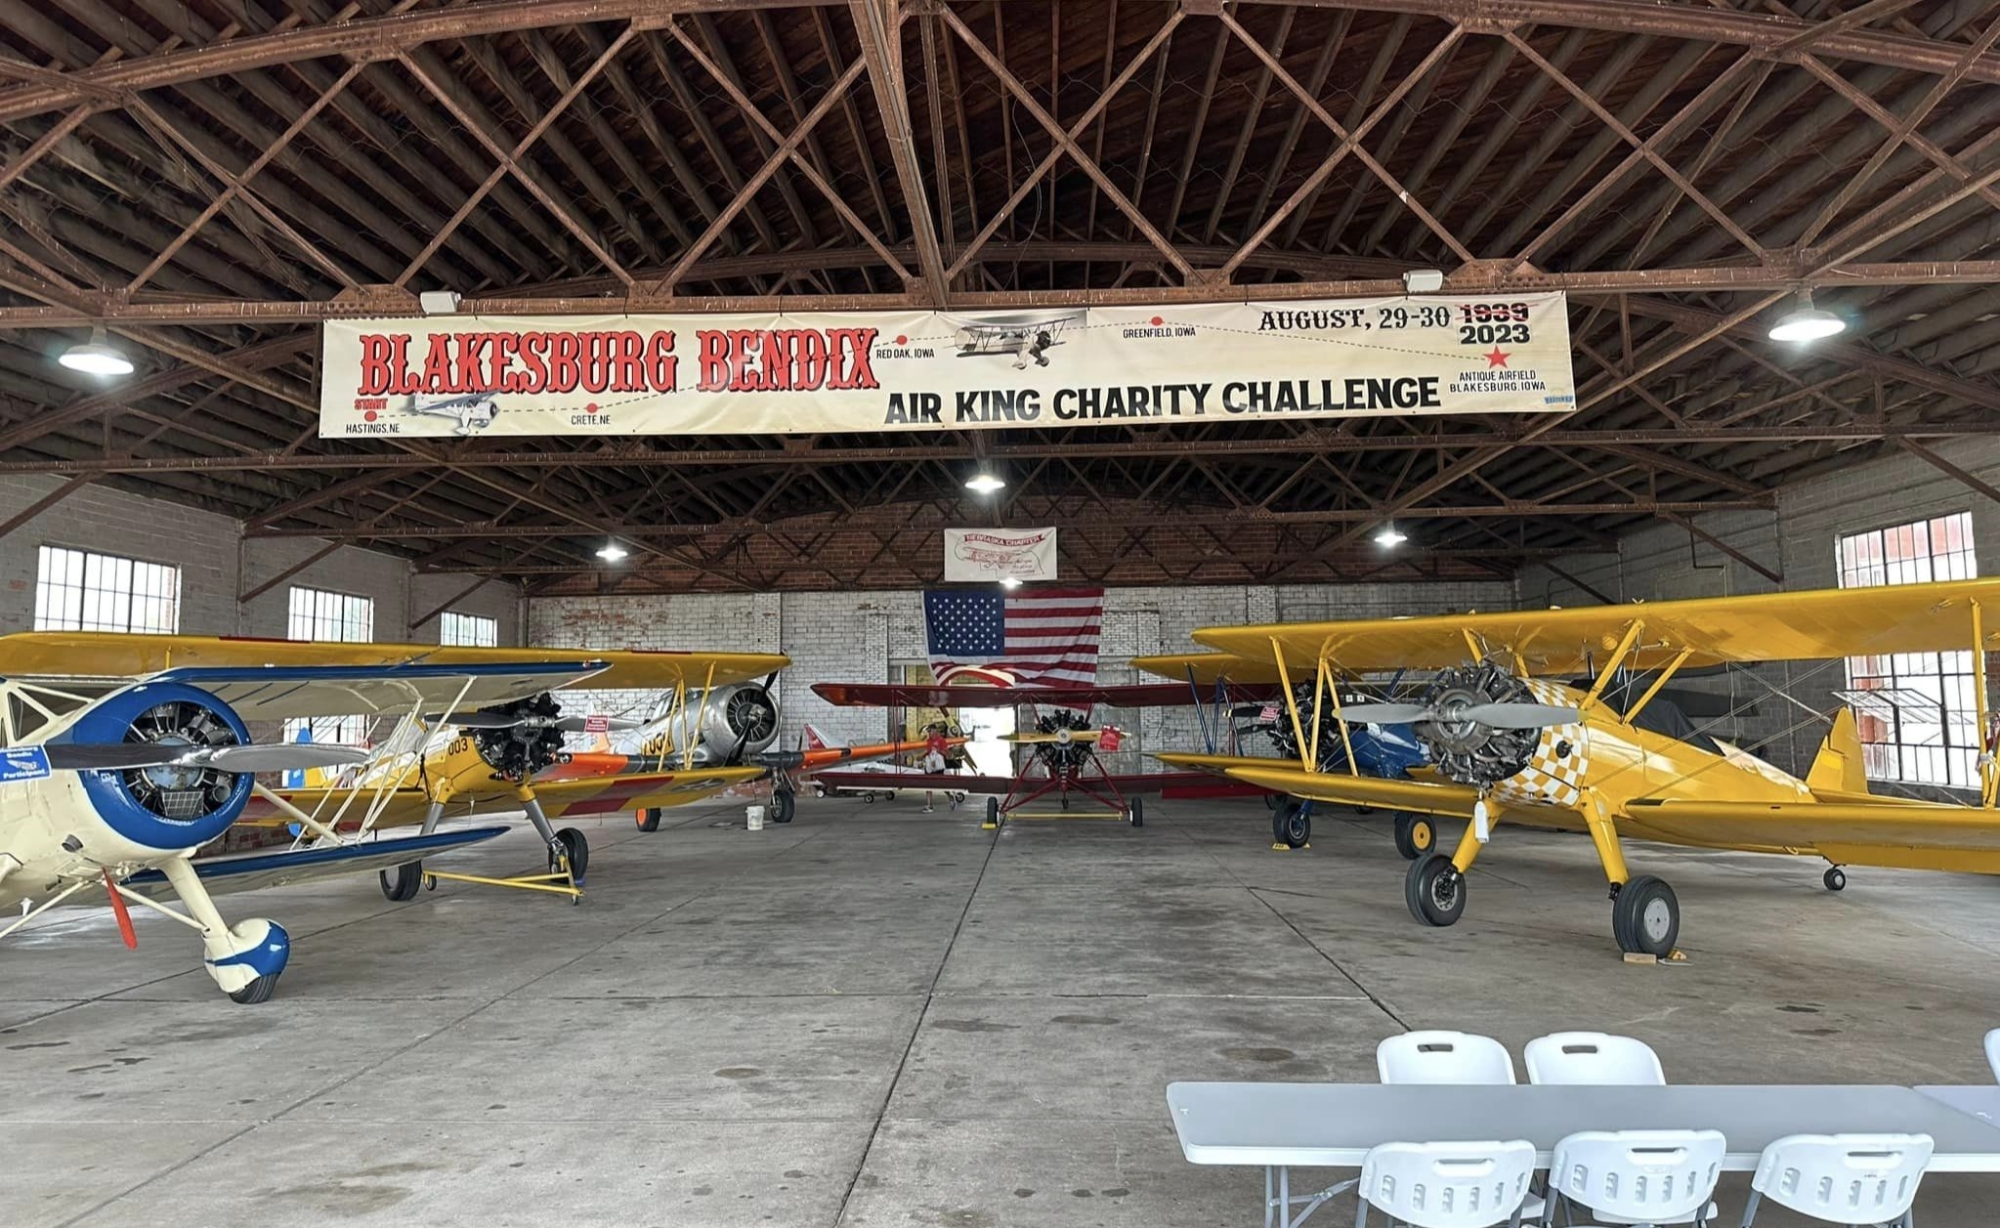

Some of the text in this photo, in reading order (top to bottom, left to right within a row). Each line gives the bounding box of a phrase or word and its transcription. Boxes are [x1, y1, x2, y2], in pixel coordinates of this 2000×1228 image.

[1258, 305, 1451, 332] AUGUST, 29-30
[1459, 302, 1530, 324] 1939
[1175, 326, 1197, 338] IOWA
[1459, 323, 1531, 345] 2023
[876, 348, 892, 359] RED
[914, 347, 935, 359] IOWA
[357, 328, 880, 396] BLAKESBURG BENDIX
[1459, 370, 1537, 381] ANTIQUE AIRFIELD
[1521, 381, 1546, 391] IOWA
[354, 398, 388, 410] START
[884, 376, 1442, 424] AIR KING CHARITY CHALLENGE
